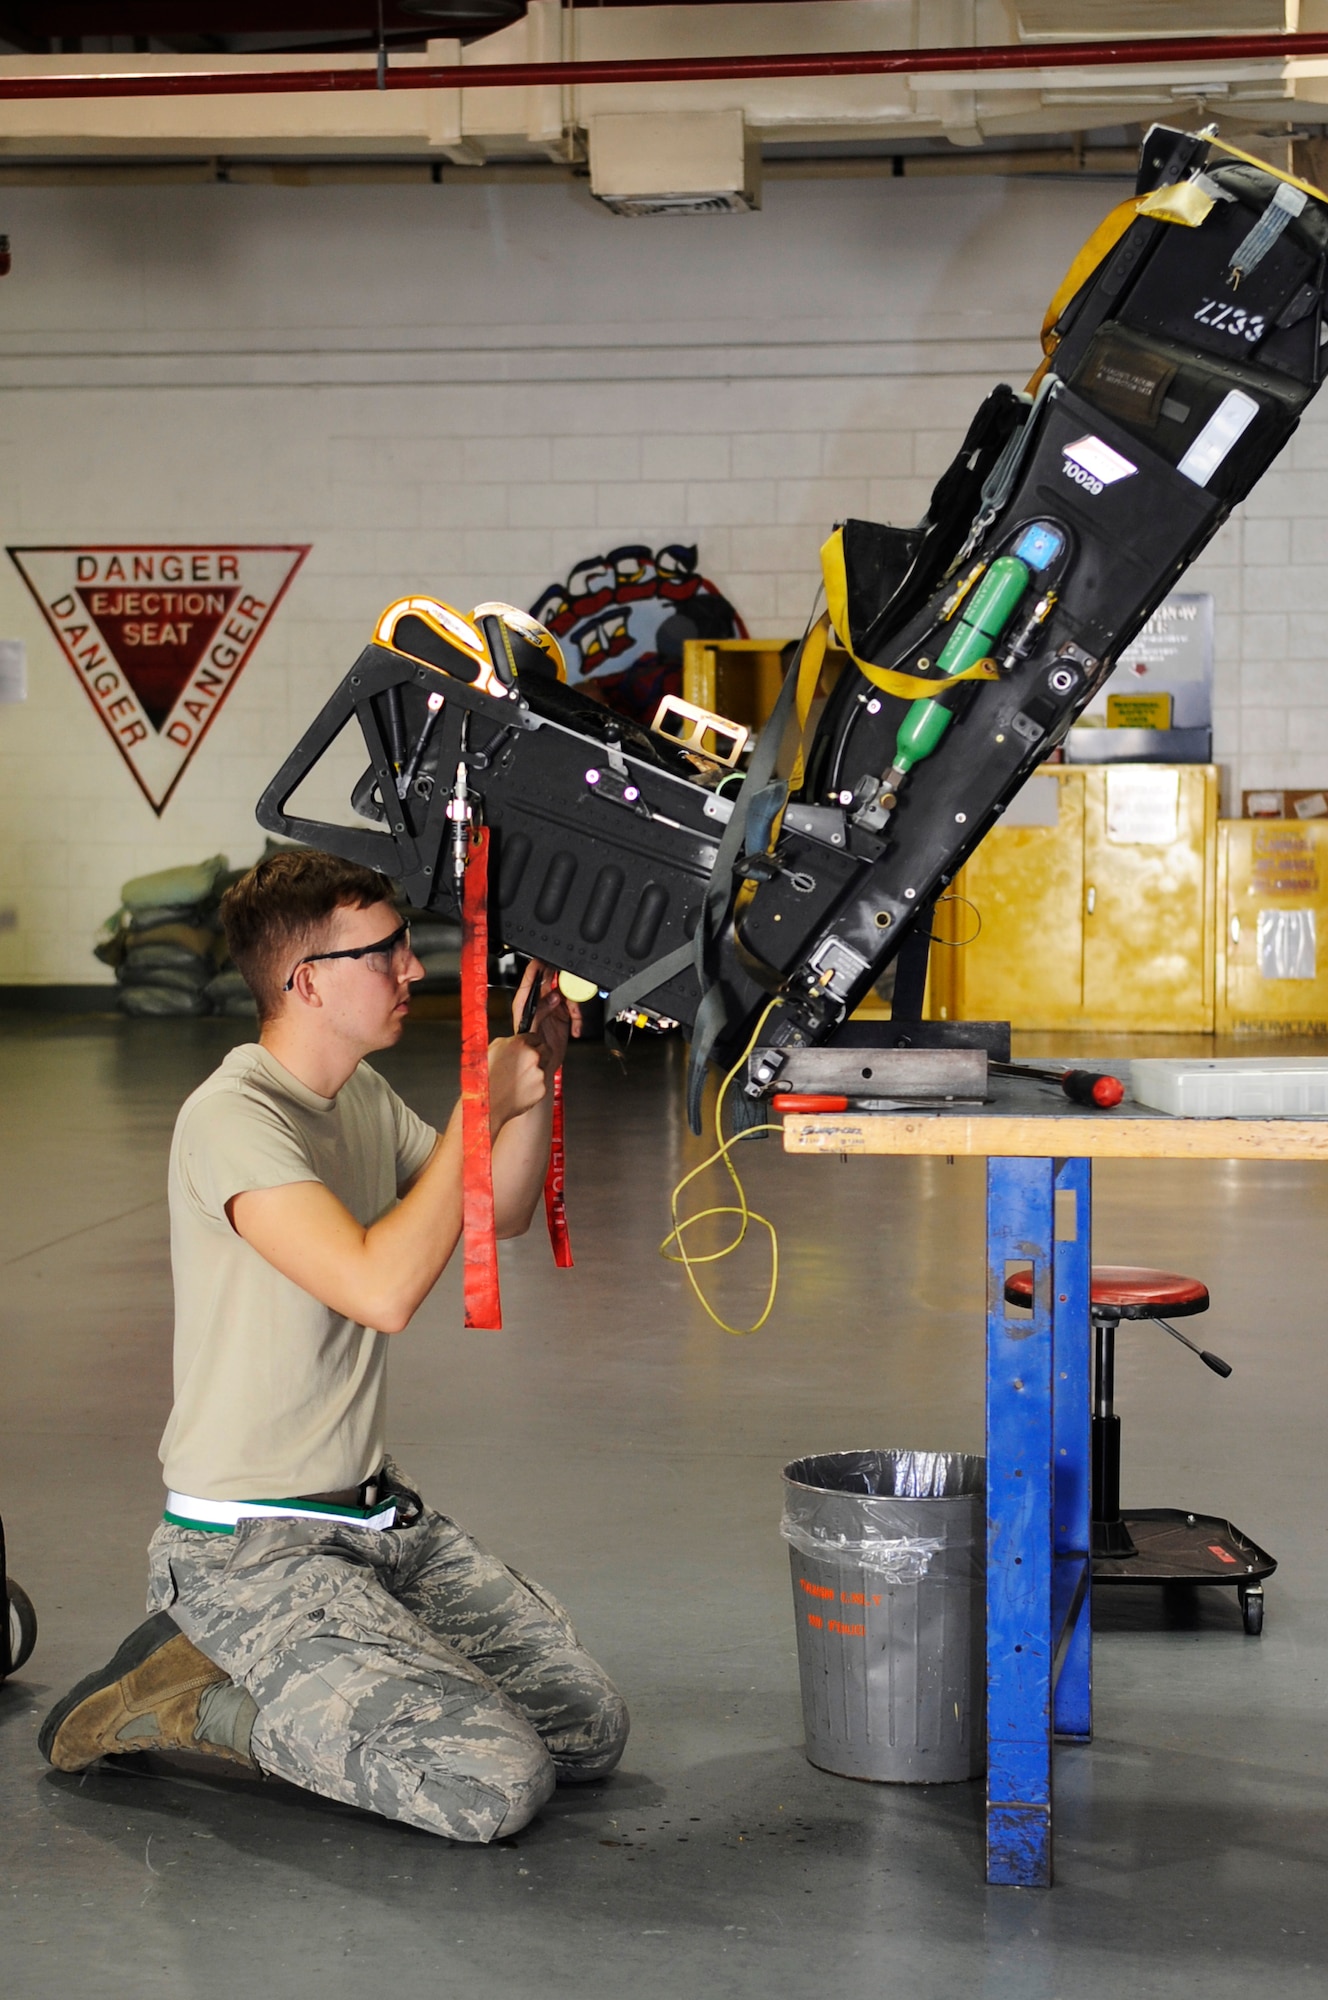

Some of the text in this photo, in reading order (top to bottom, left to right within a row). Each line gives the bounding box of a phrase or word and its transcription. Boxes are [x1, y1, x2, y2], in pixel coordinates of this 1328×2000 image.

[1062, 460, 1104, 496] 10029
[76, 555, 240, 582] DANGER
[92, 593, 226, 616] EJECTION
[122, 622, 194, 647] SEAT
[50, 592, 148, 748] DANGER
[166, 594, 267, 748] DANGER
